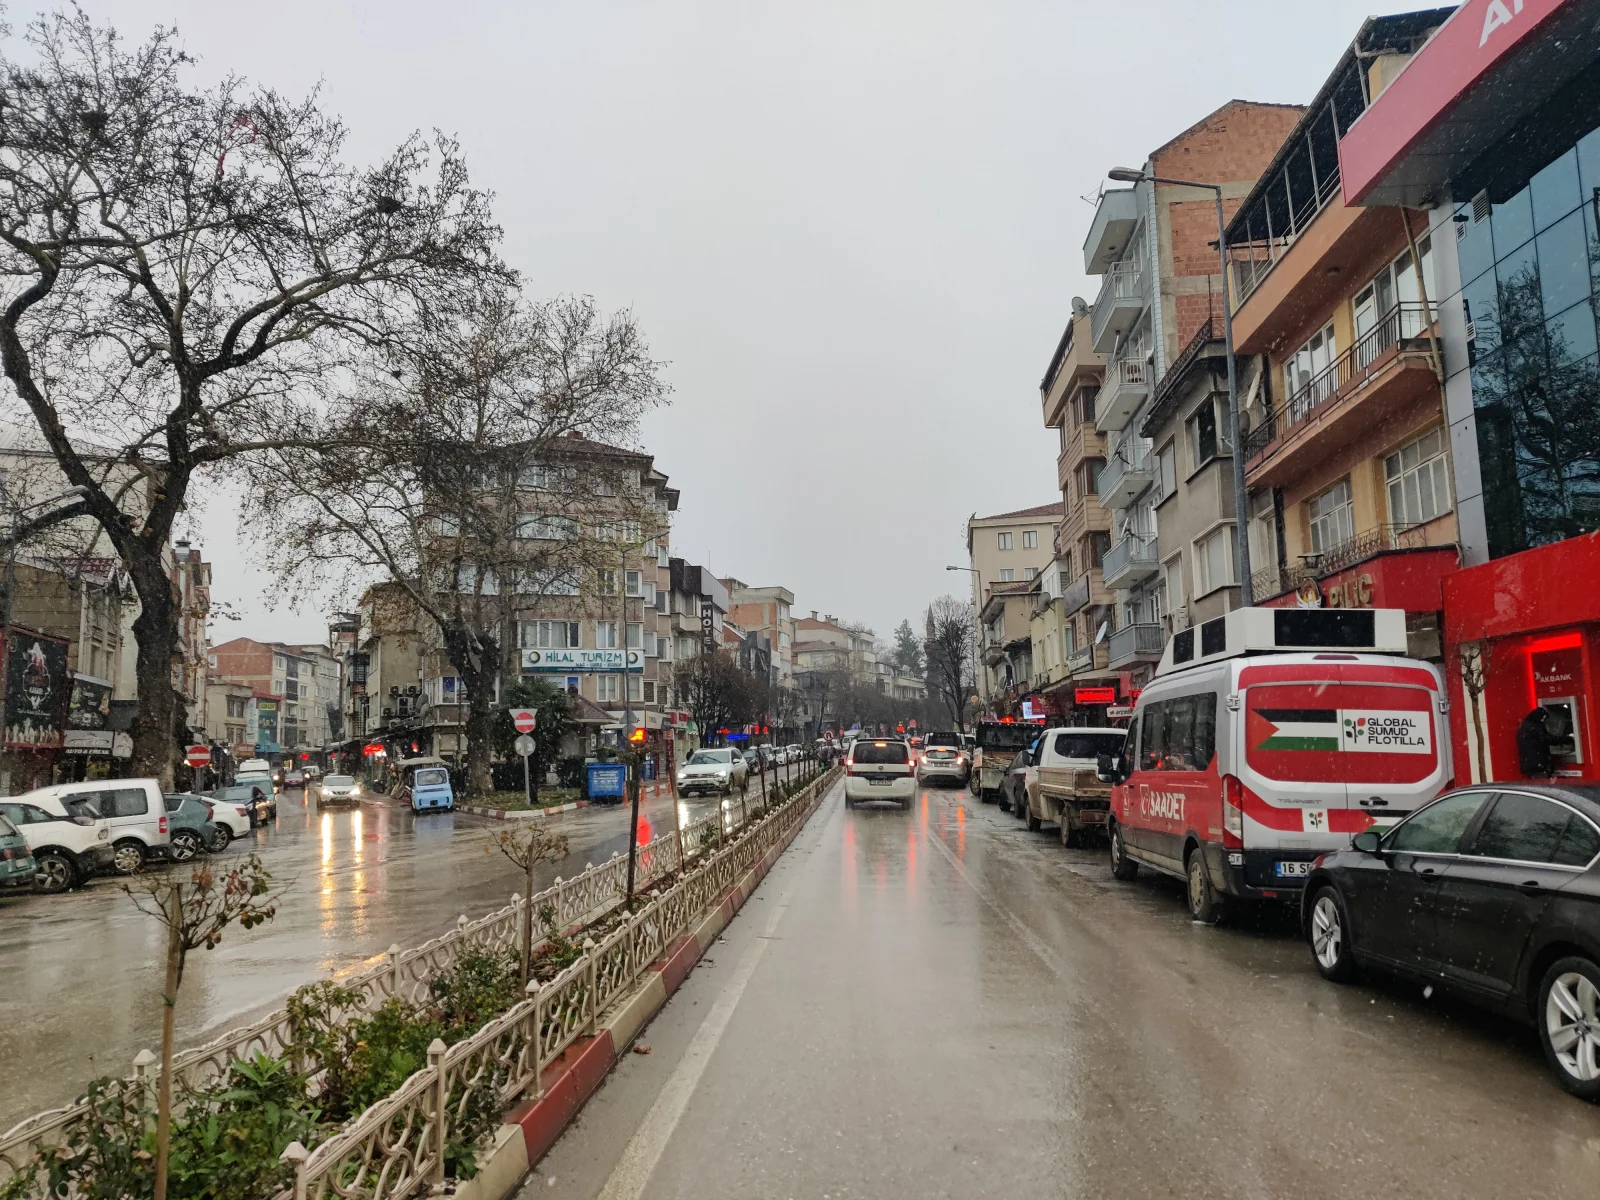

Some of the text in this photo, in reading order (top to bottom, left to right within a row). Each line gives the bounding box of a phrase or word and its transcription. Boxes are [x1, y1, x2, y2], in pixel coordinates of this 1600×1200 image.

[1478, 0, 1524, 48] A
[702, 609, 712, 654] HOTEL
[545, 650, 622, 662] HİLAL TURİZM
[1540, 673, 1572, 683] AKBANK
[1367, 717, 1416, 727] GLOBAL
[1368, 726, 1409, 736] SUMUD
[1368, 735, 1425, 746] FLOTILLA
[1150, 791, 1186, 820] SAADET
[1282, 863, 1294, 873] 16
